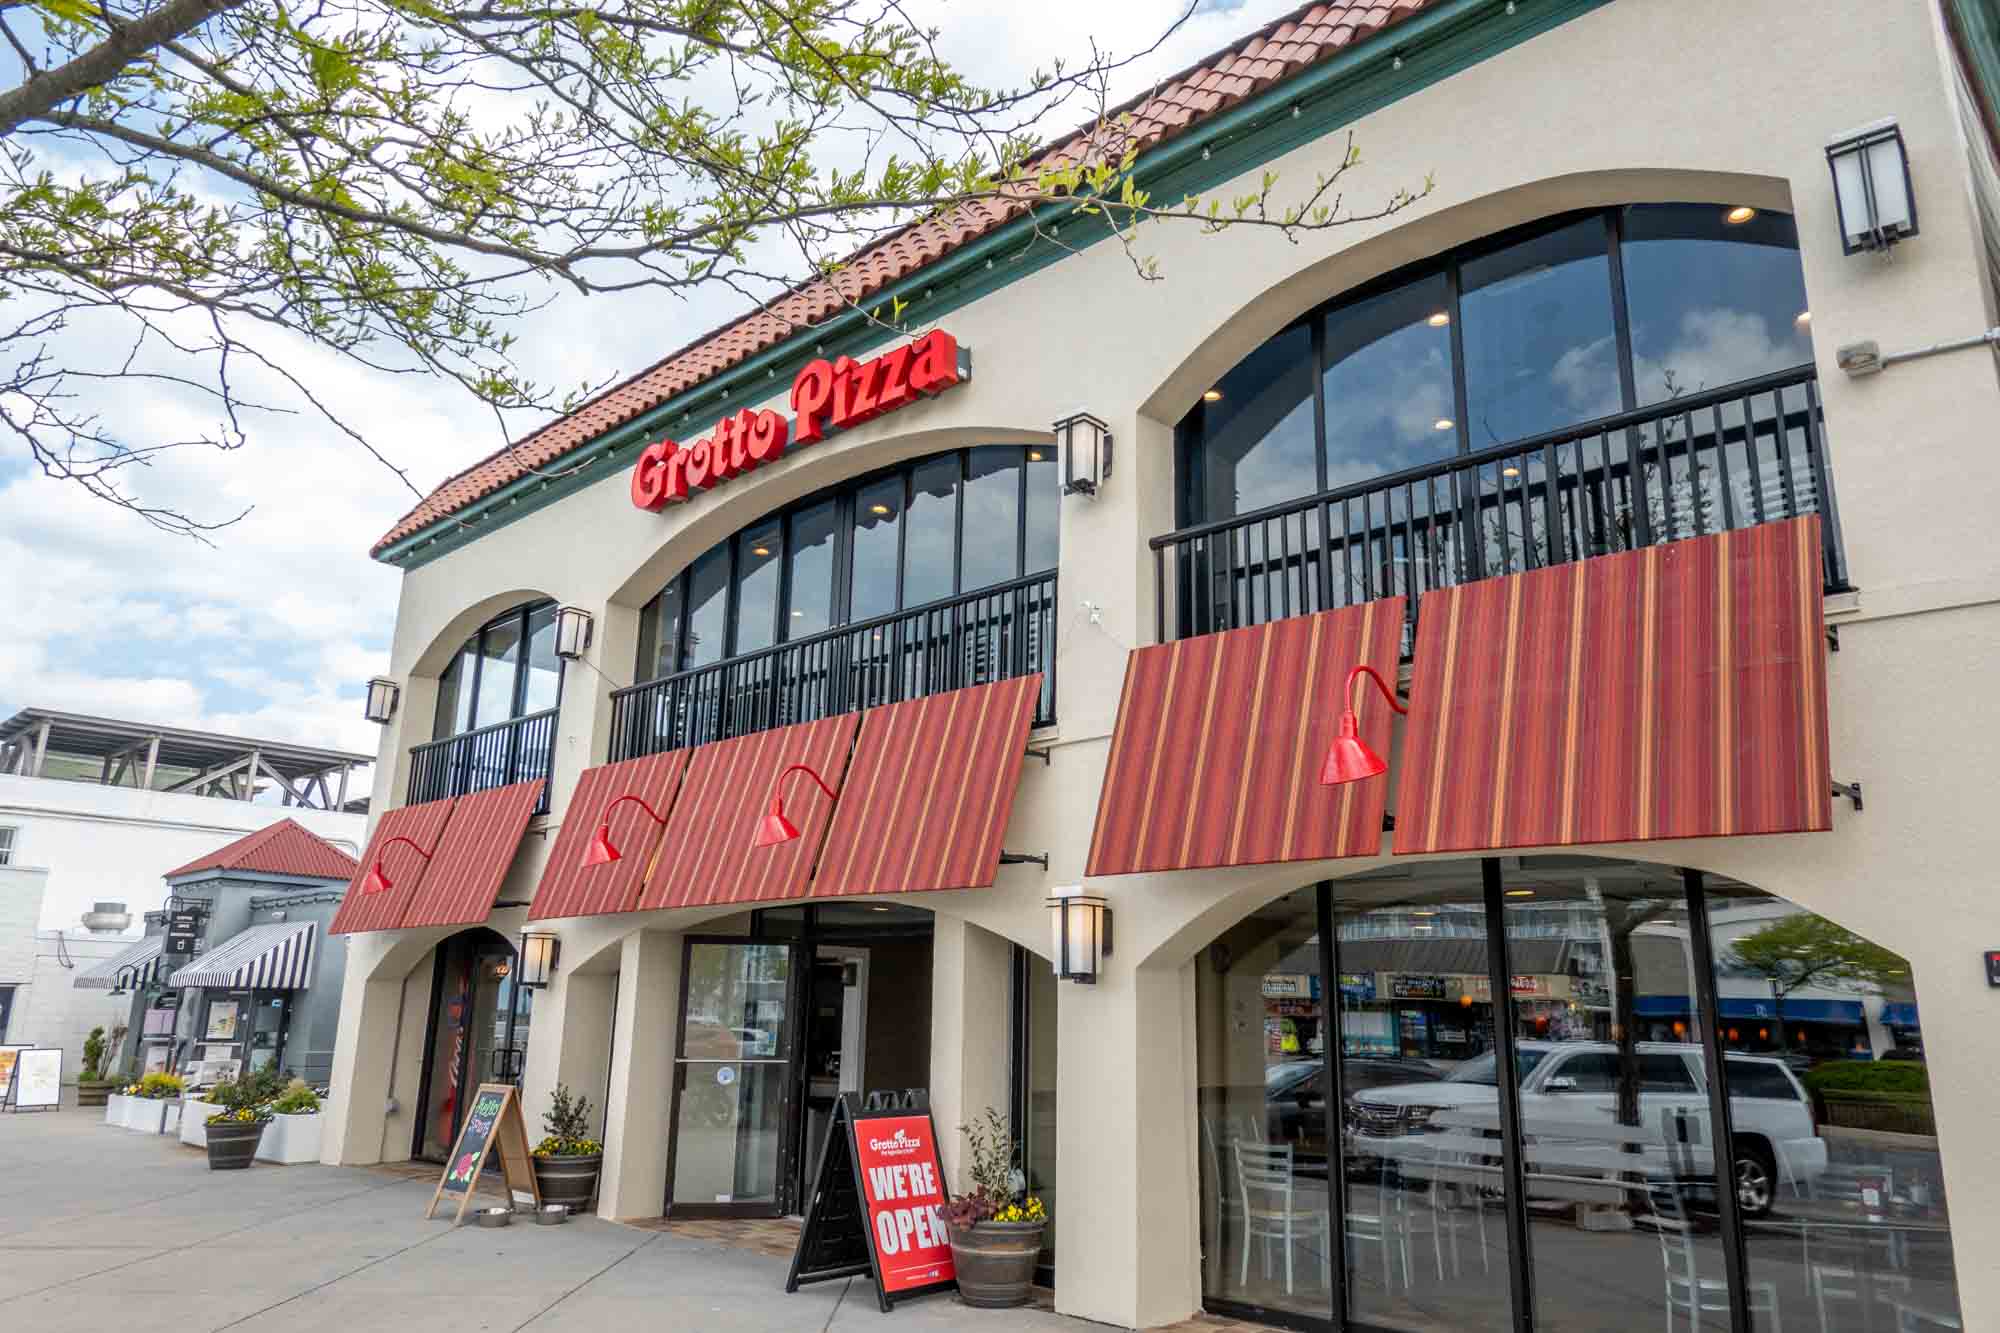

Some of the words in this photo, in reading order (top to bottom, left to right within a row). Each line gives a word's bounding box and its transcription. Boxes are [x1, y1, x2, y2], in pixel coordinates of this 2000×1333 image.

[631, 407, 788, 513] Grotto
[791, 328, 960, 445] Pizza
[869, 1138, 898, 1151] Grotto
[868, 1161, 937, 1201] WE'RE
[876, 1203, 950, 1255] OPEN
